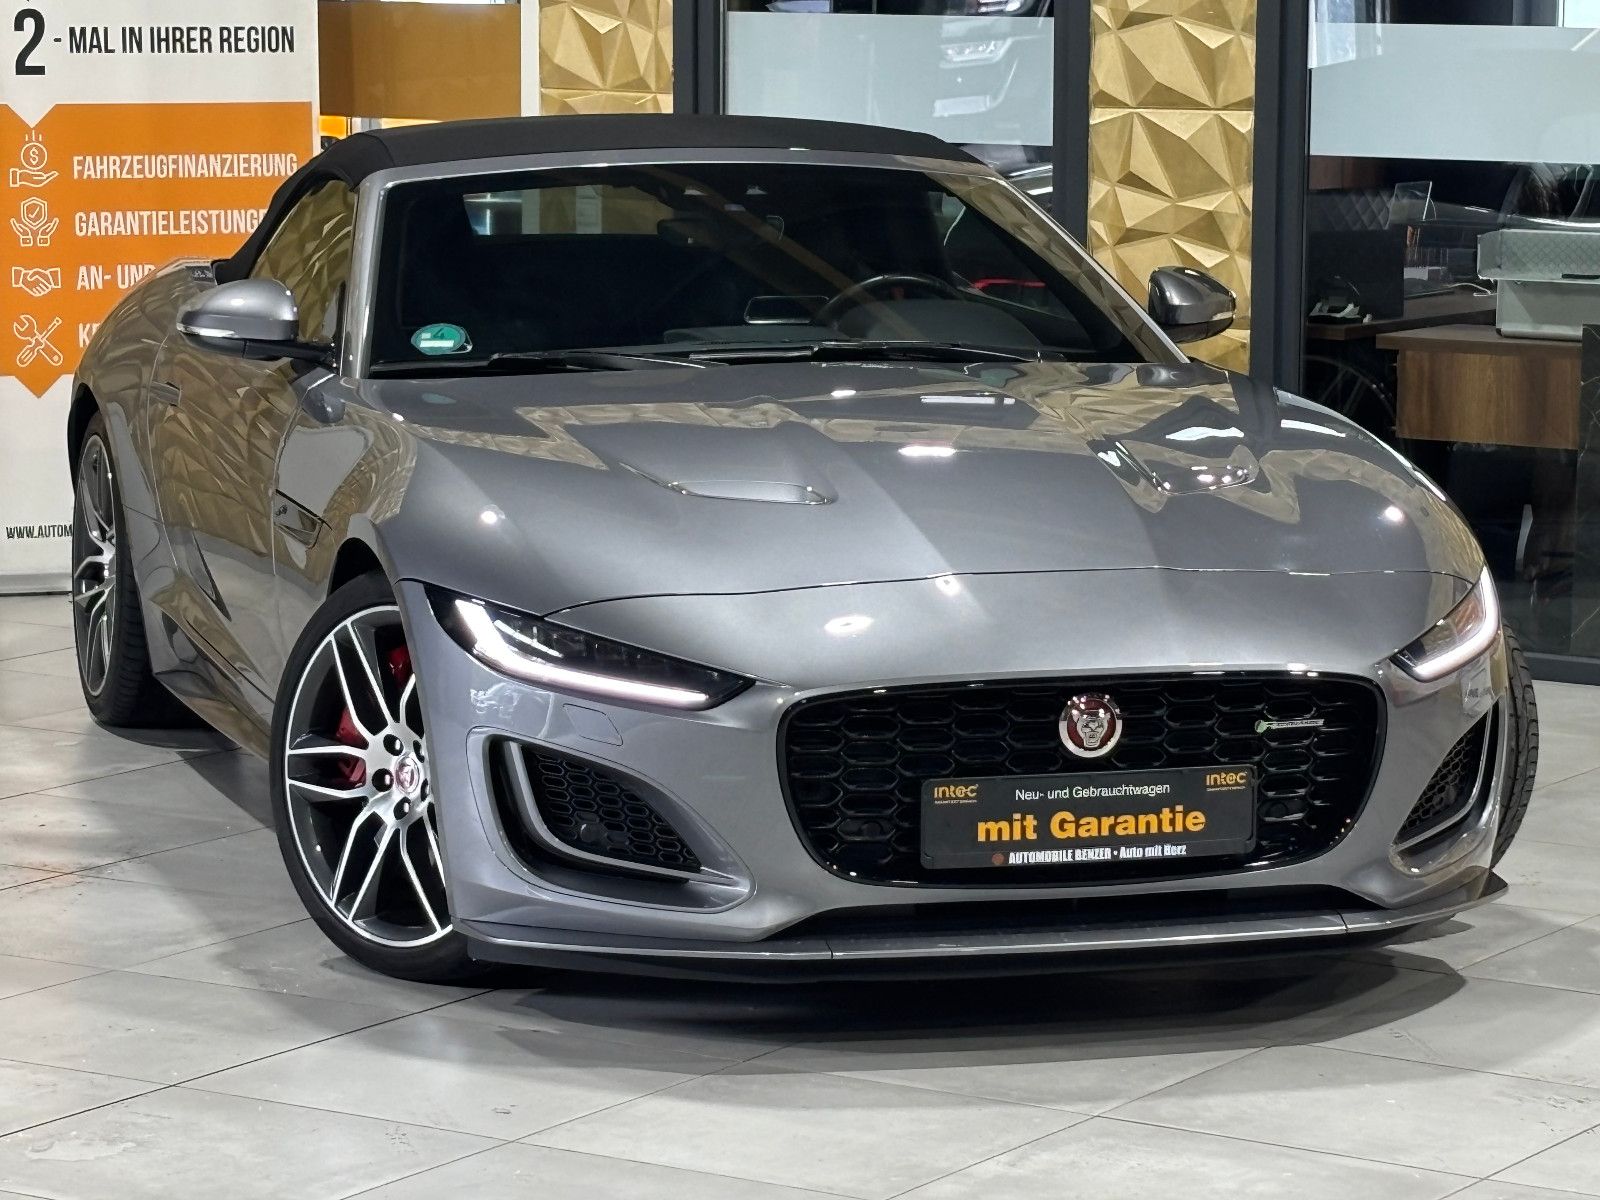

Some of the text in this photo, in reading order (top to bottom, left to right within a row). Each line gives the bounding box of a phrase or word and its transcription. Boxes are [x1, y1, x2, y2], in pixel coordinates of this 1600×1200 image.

[13, 8, 46, 76] 2
[68, 26, 116, 54] MAL
[121, 26, 143, 53] IN
[150, 26, 213, 53] IHRER
[219, 25, 295, 53] REGION
[72, 153, 298, 180] FAHRZEUGFINANZIERUNG
[76, 265, 111, 290] AN-
[1015, 783, 1171, 801] Neu- und Gebrauchtwagen
[977, 804, 1207, 843] mit Garantie
[1008, 849, 1074, 864] AUTOMOBILE
[1119, 846, 1143, 859] Auto
[1144, 844, 1162, 857] mit
